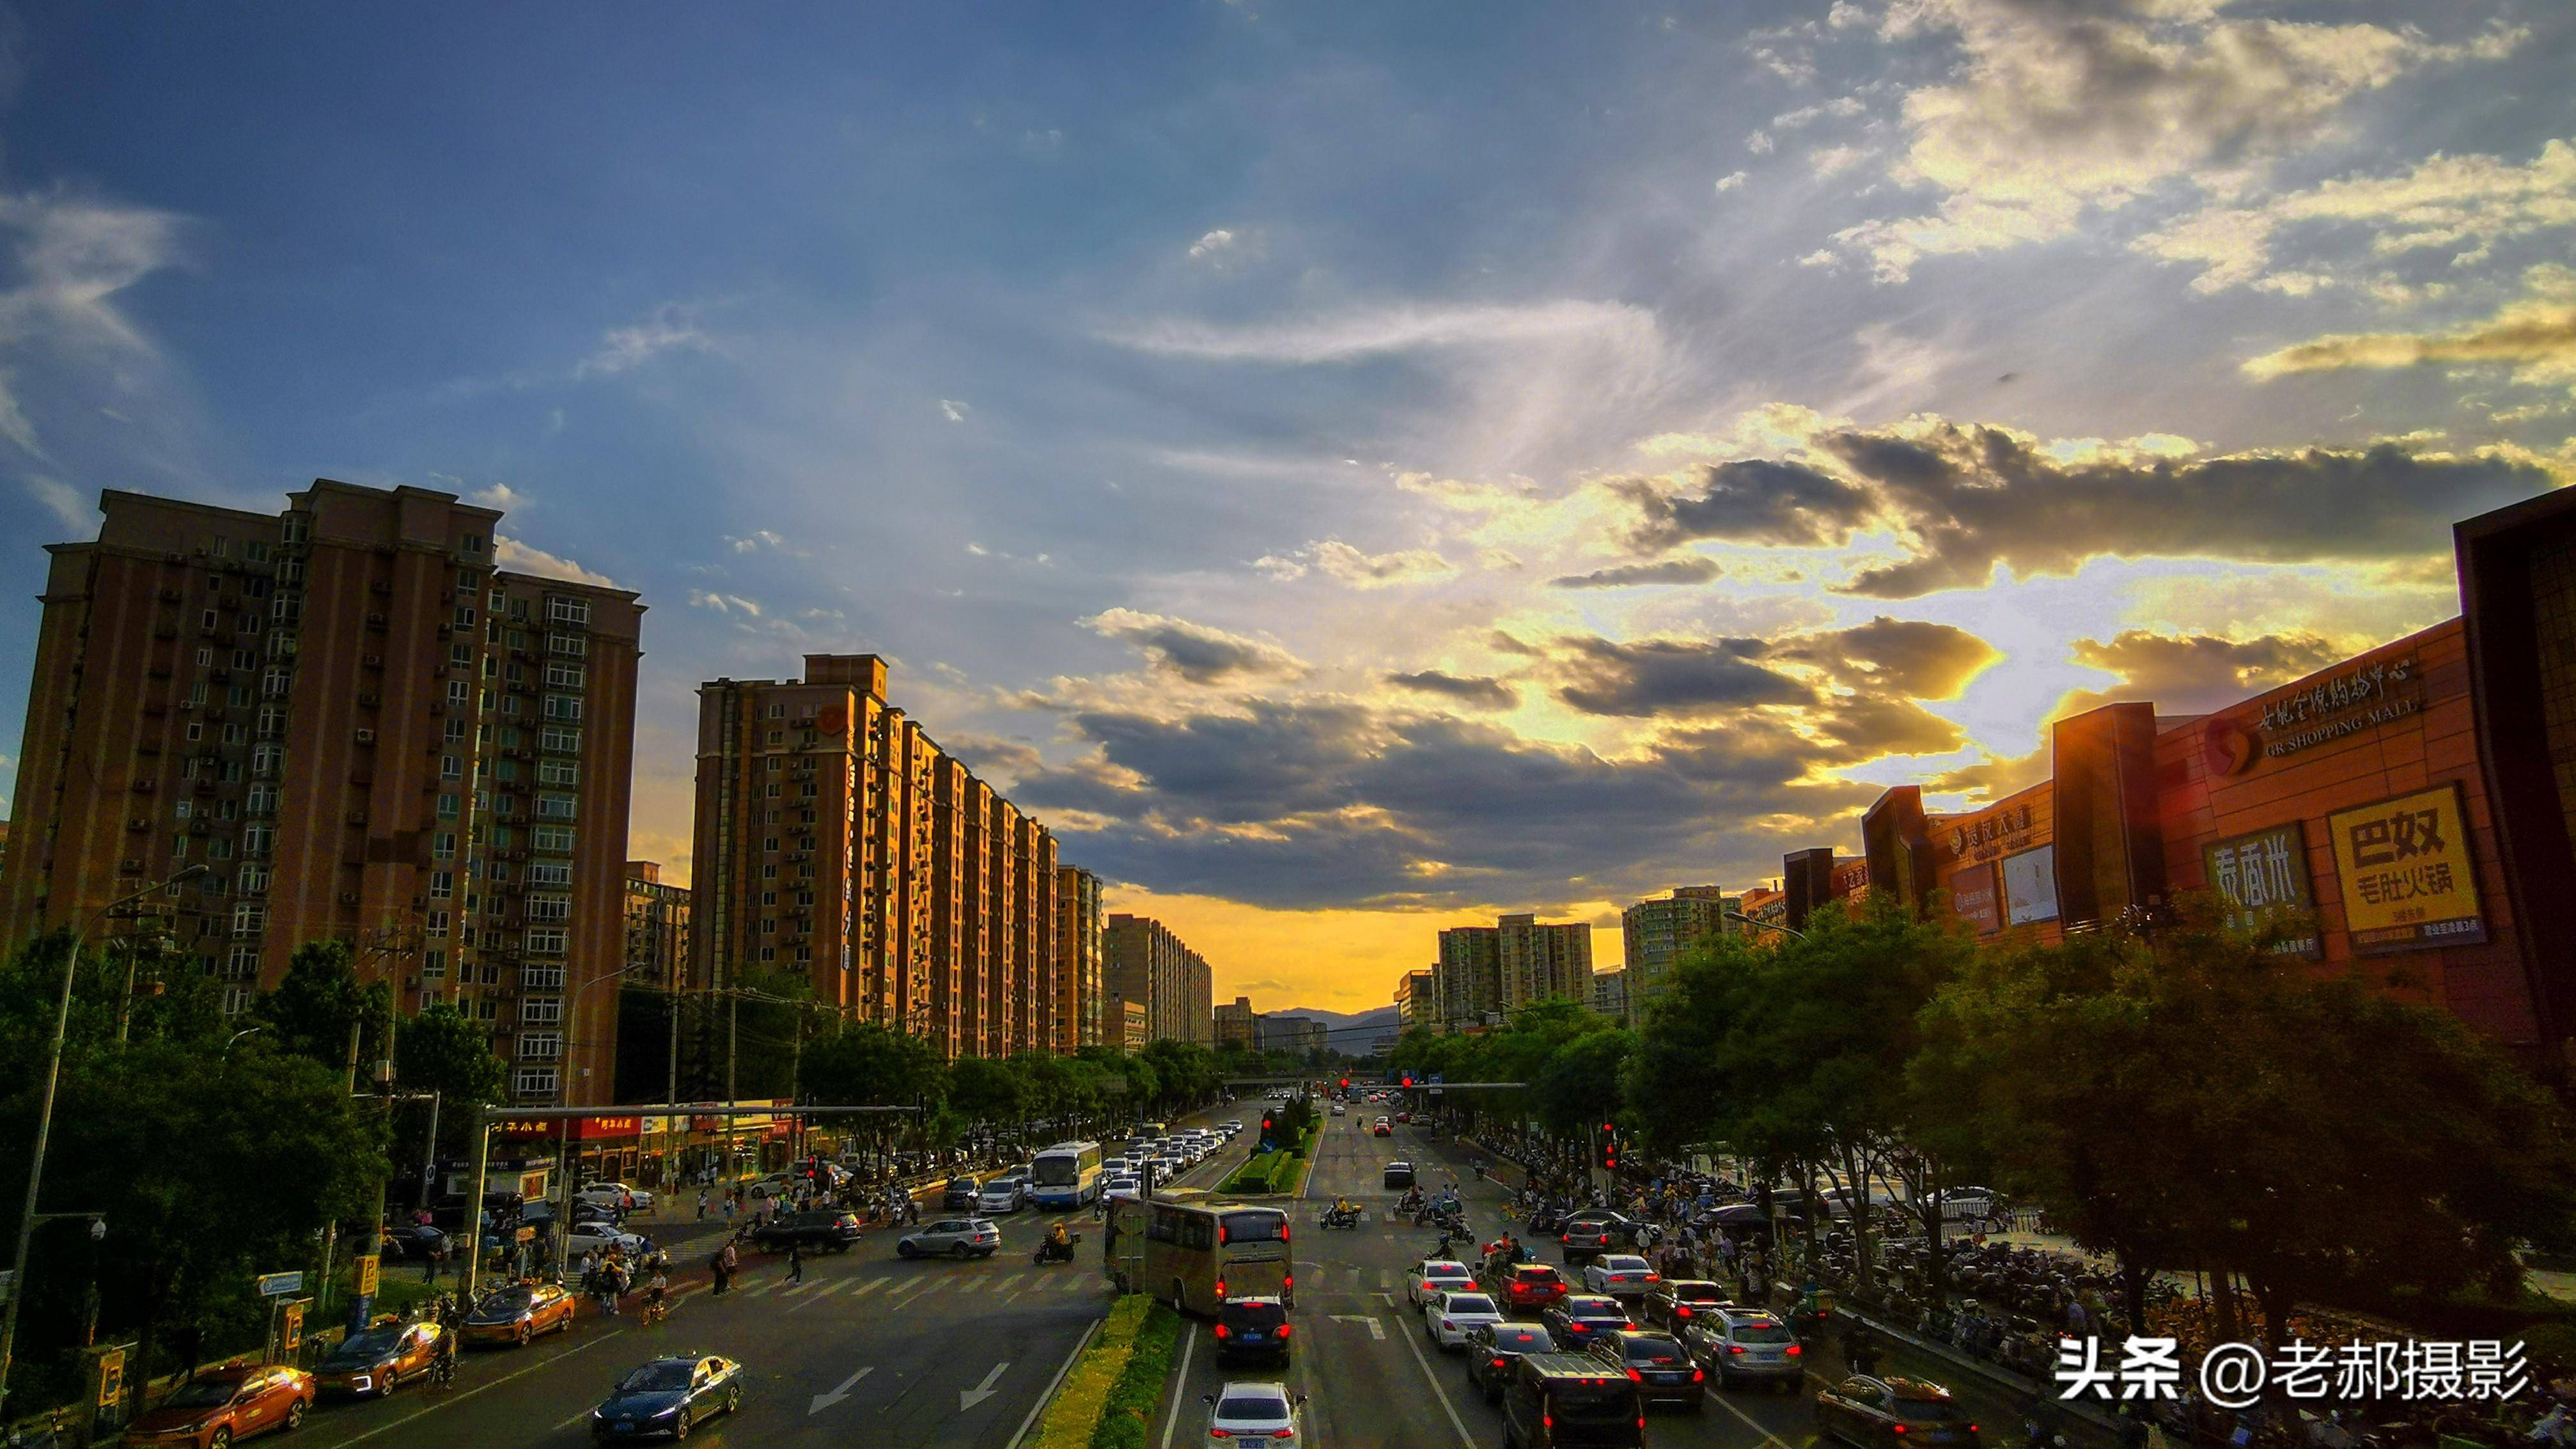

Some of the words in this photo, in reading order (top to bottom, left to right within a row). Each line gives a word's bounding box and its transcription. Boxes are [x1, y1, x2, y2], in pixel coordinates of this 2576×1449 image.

[2265, 742, 2285, 757] GR
[2287, 716, 2362, 752] SHOPPING
[2367, 699, 2418, 726] MALL
[2348, 807, 2446, 870] 巴奴
[2357, 862, 2455, 905] 毛肚火锅
